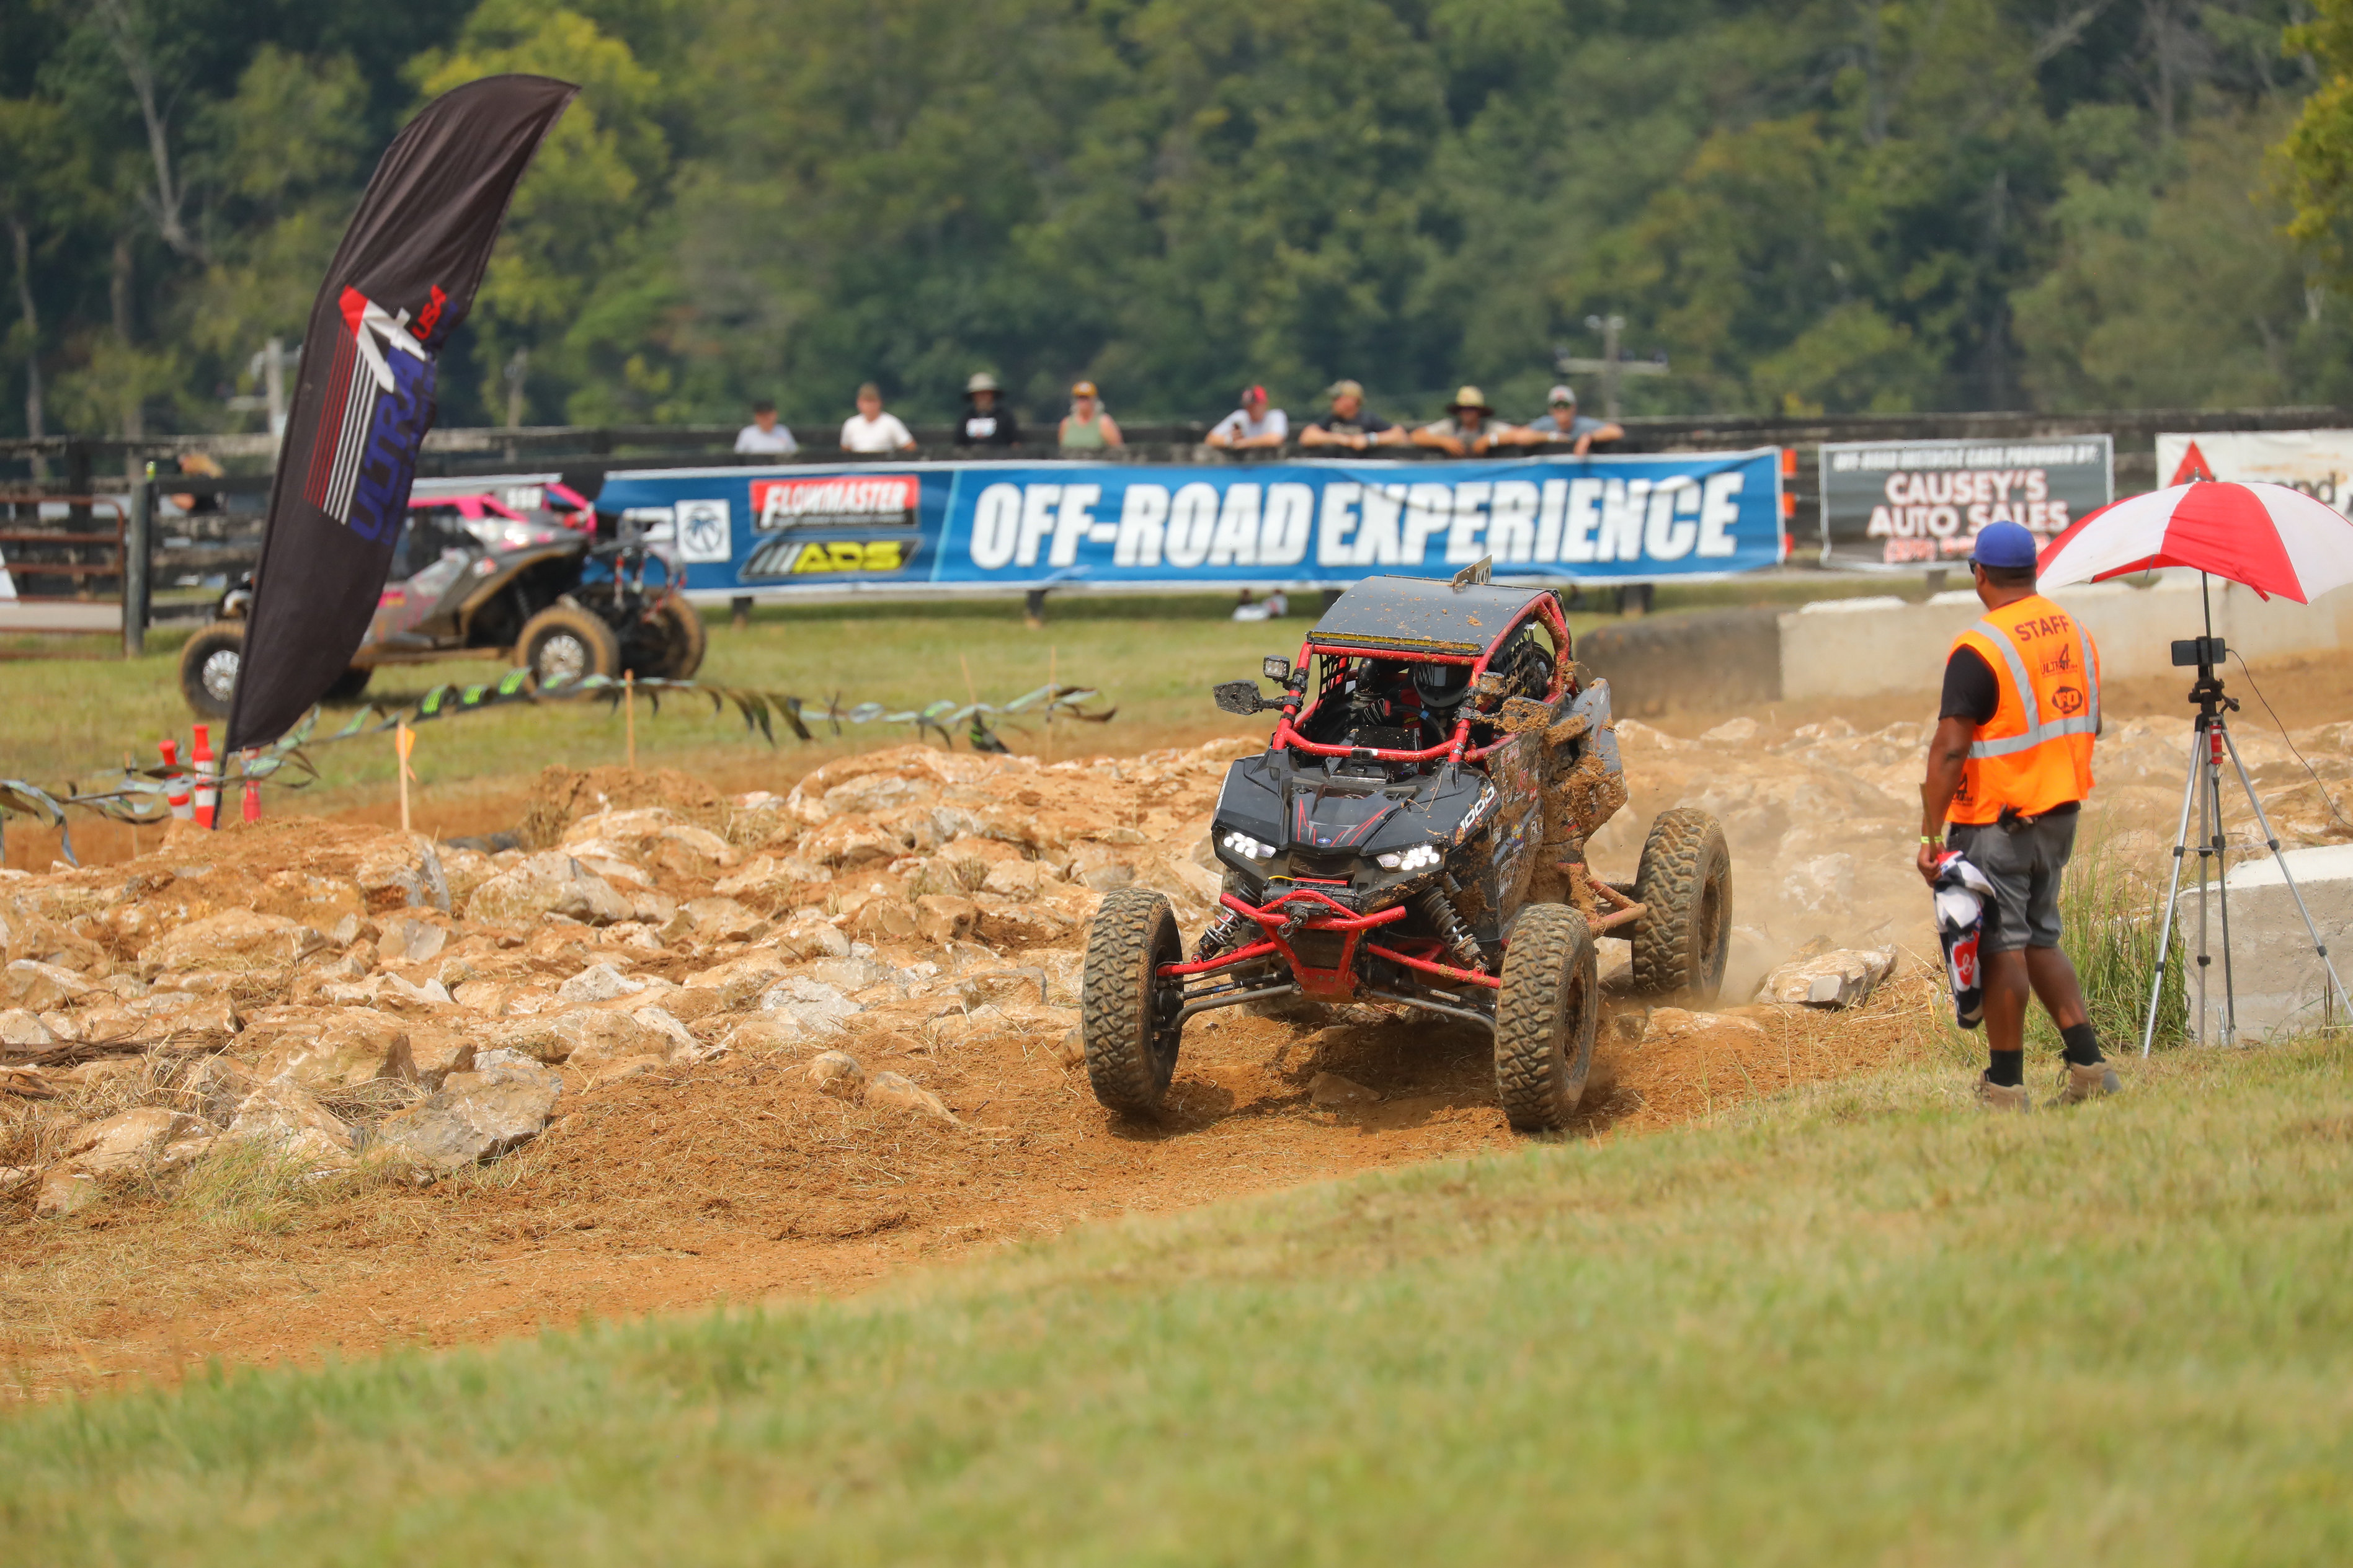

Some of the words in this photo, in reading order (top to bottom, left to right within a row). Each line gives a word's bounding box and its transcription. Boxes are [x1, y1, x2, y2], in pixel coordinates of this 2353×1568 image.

[412, 285, 447, 340] USA
[350, 345, 424, 541] ULTRA
[760, 481, 909, 528] FLOWMASTER
[1885, 469, 2048, 505] CAUSEY'S
[969, 482, 1314, 570] OFF-ROAD
[1317, 472, 1744, 565] EXPERIENCE
[1867, 505, 1960, 538] AUTO
[1967, 500, 2070, 536] SALES
[793, 540, 903, 572] ADS
[2014, 615, 2069, 642] STAFF
[1459, 786, 1495, 833] 1000
